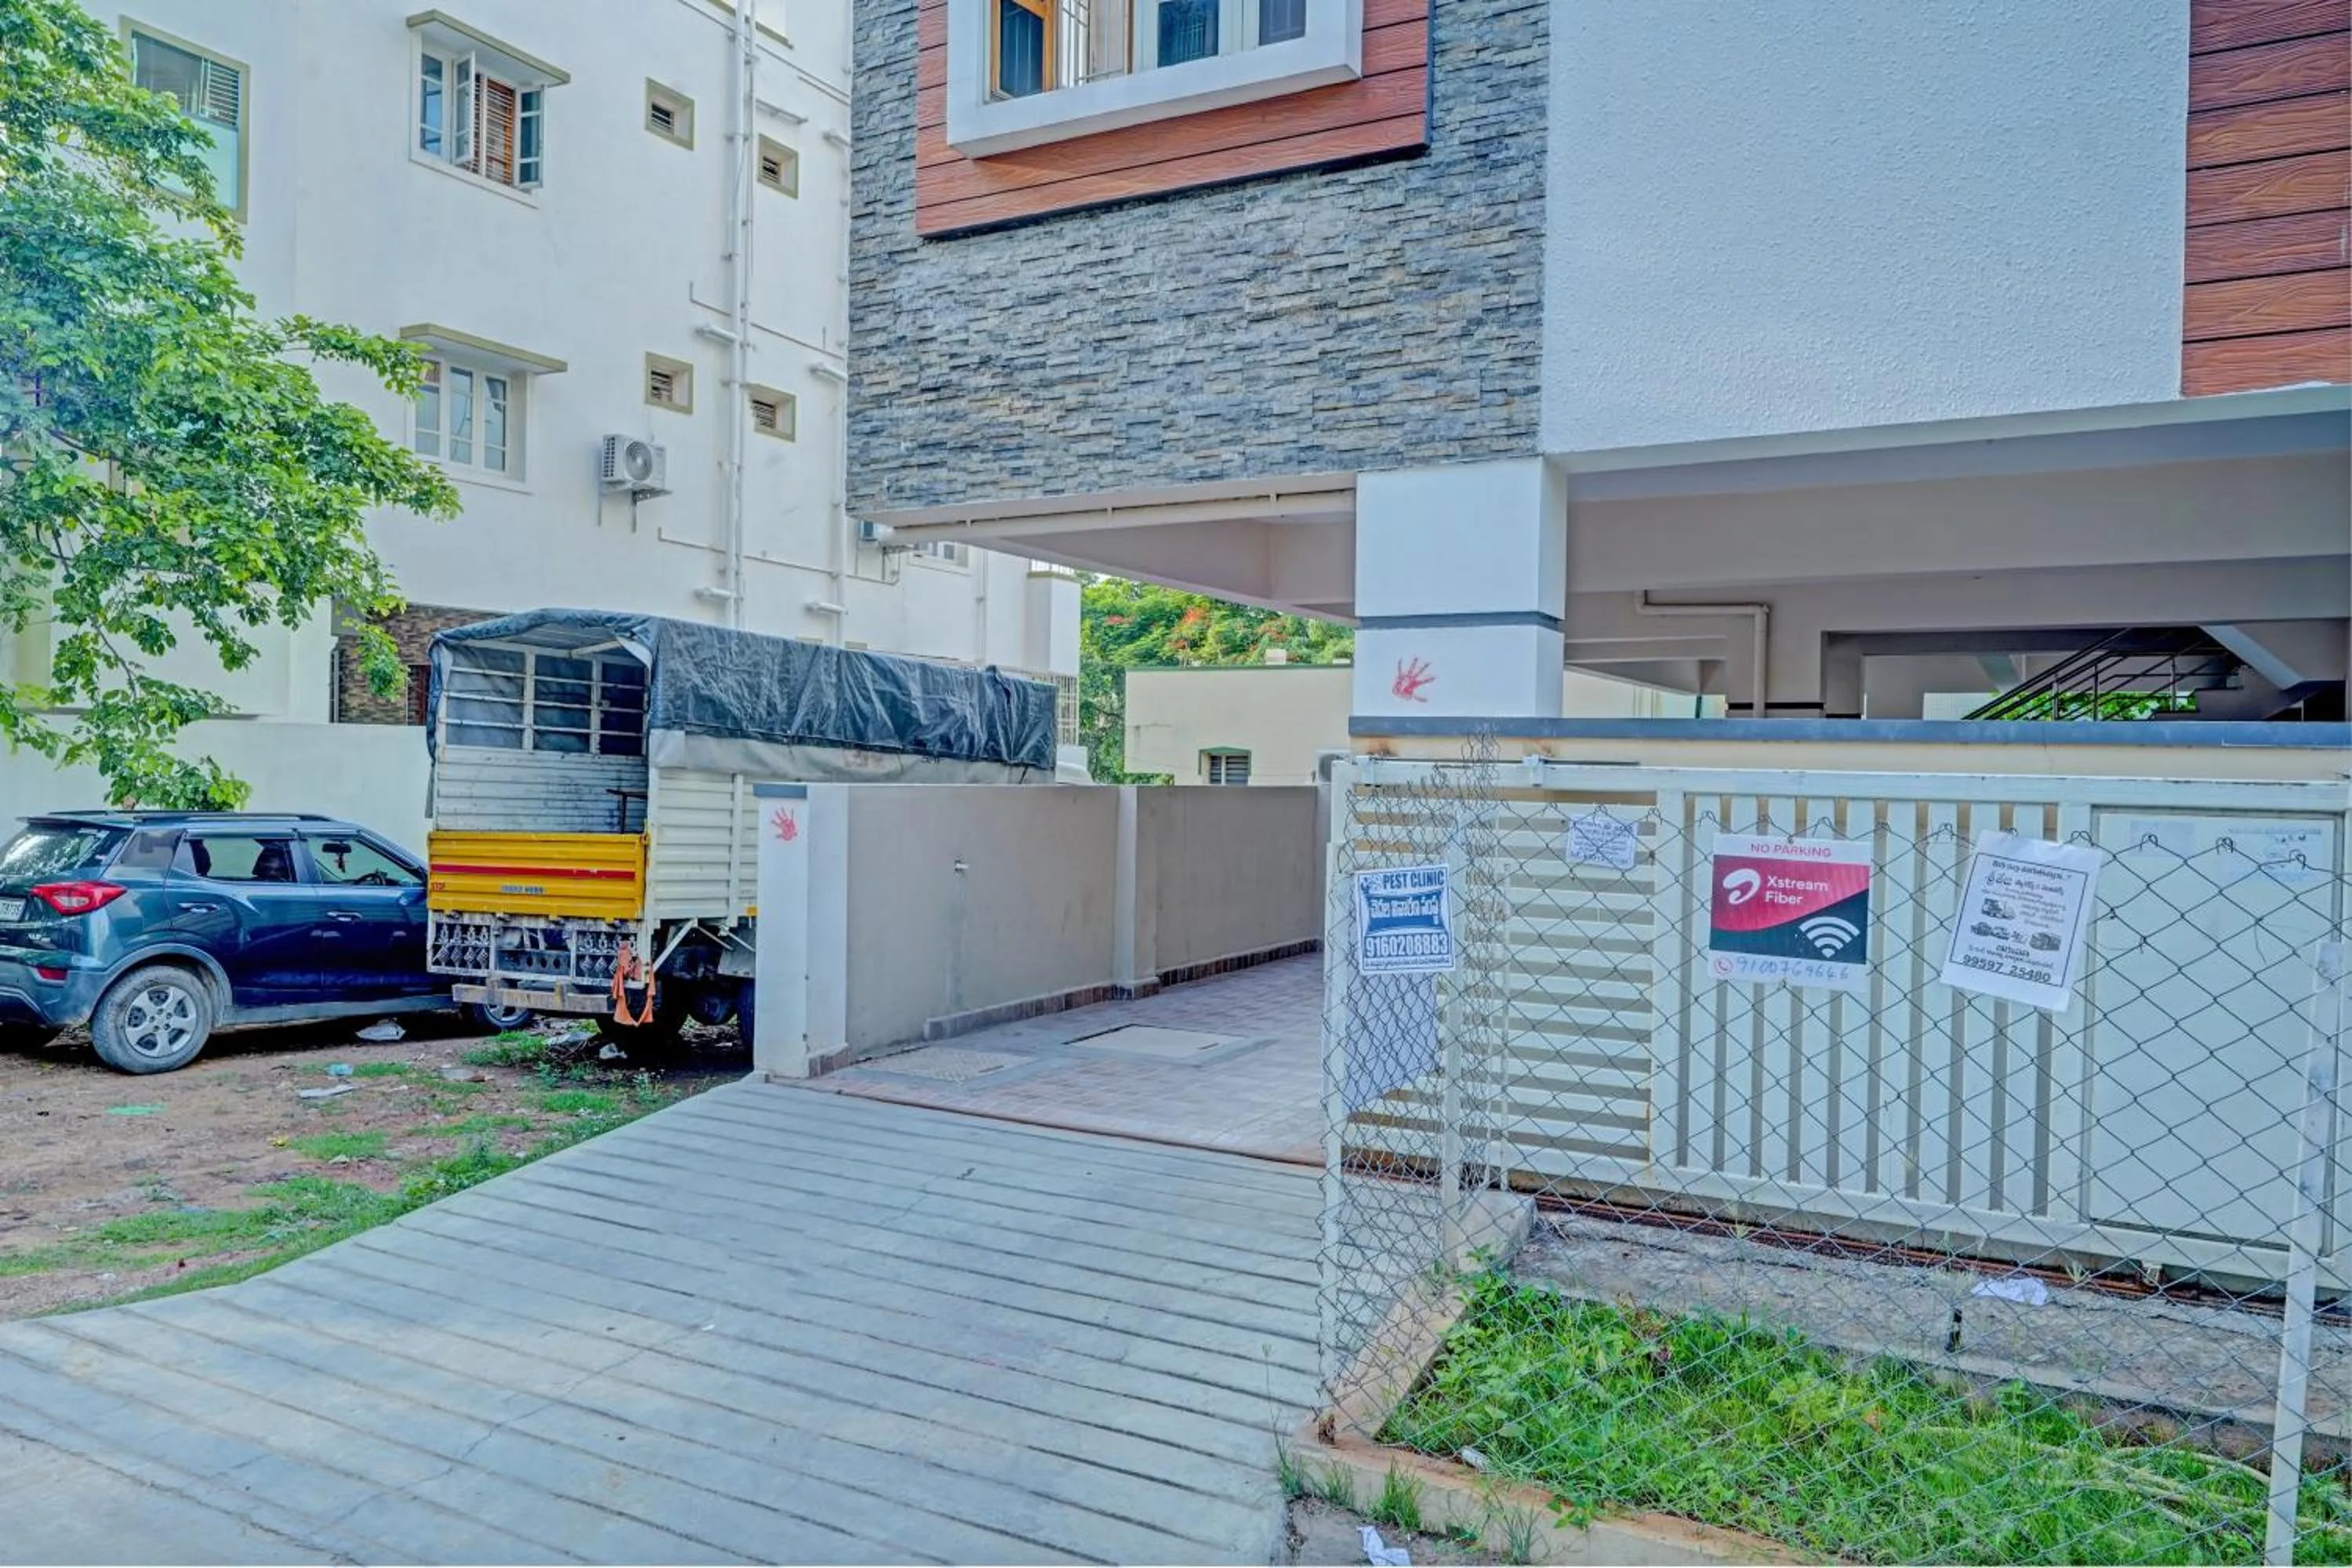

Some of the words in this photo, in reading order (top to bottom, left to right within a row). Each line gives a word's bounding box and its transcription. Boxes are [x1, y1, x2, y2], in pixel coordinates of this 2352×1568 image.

[1750, 843, 1770, 853] NO
[1773, 844, 1832, 858] PARKING
[1382, 873, 1407, 890] PEST
[1410, 869, 1445, 888] CLINIC
[1766, 874, 1829, 891] Xstream
[1764, 890, 1804, 905] Fiber
